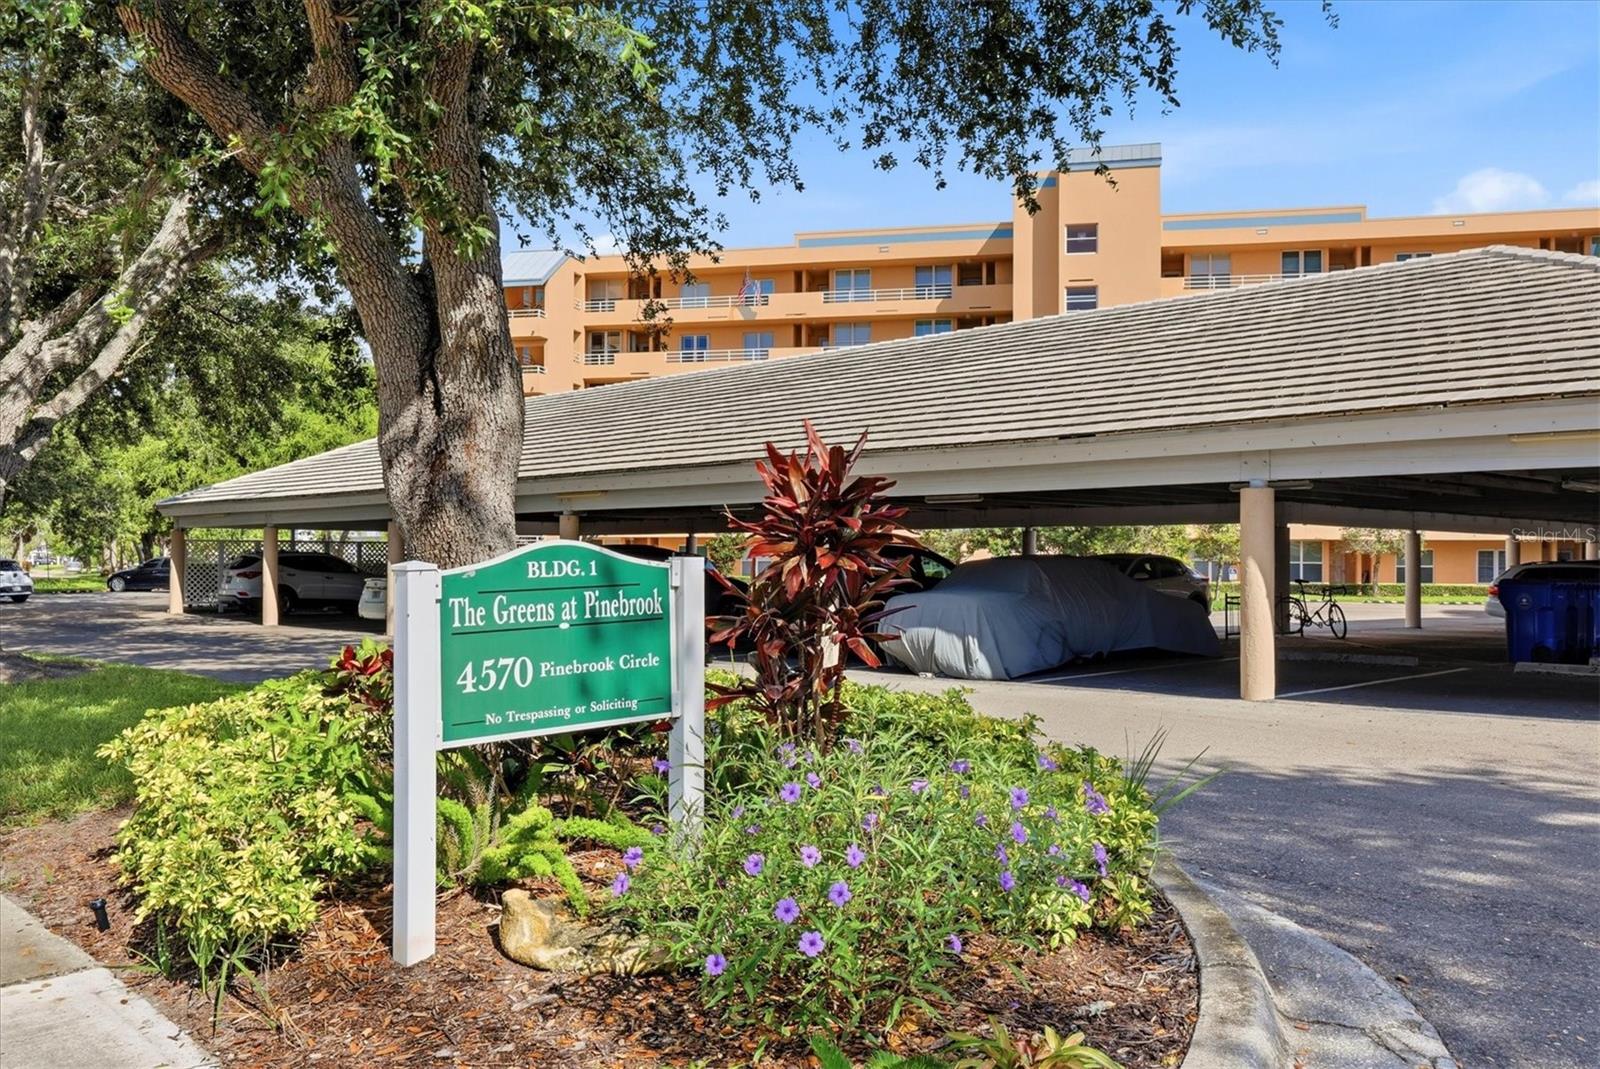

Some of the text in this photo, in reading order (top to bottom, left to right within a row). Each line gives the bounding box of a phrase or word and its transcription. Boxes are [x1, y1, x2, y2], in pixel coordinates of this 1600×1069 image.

[527, 560, 598, 578] BLDG. 1
[449, 588, 663, 628] The Greens at Pinebrook
[456, 653, 660, 694] 4570 Pinebrook Circle
[485, 699, 638, 726] No Trespassing or Soliciting
